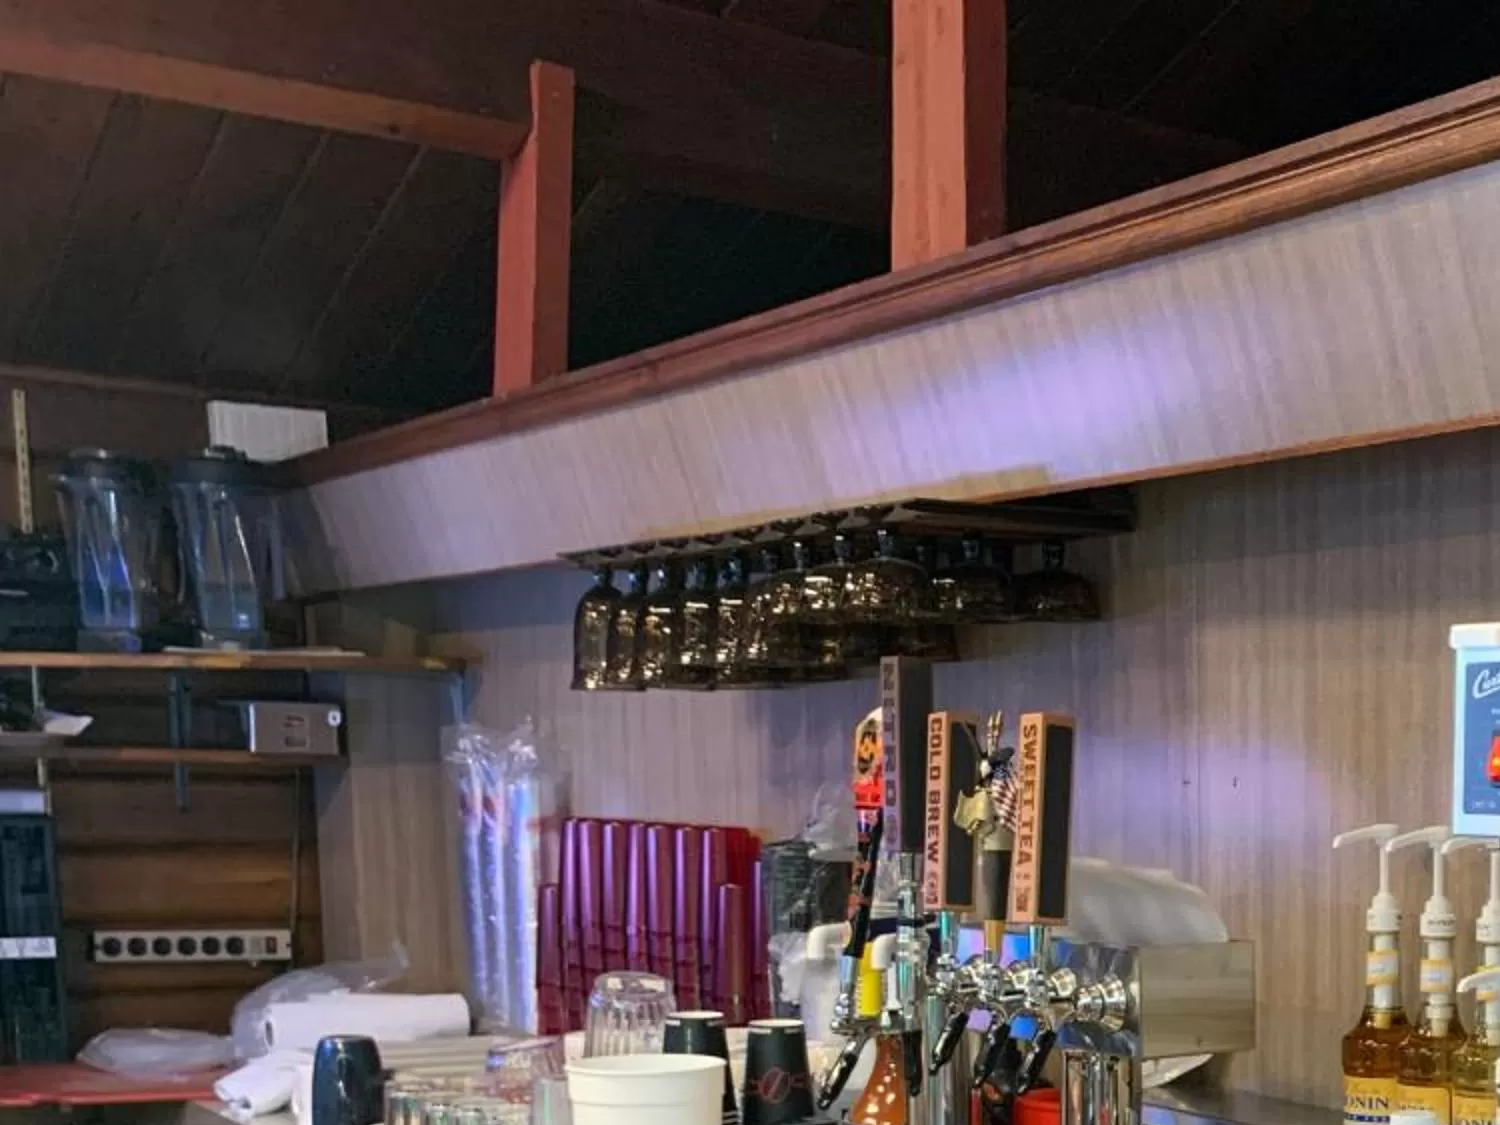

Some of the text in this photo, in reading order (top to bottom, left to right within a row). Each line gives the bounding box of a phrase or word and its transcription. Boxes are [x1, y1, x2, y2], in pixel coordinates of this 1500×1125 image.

[927, 717, 943, 864] COLD BREW
[1016, 722, 1038, 865] SWEET TEA
